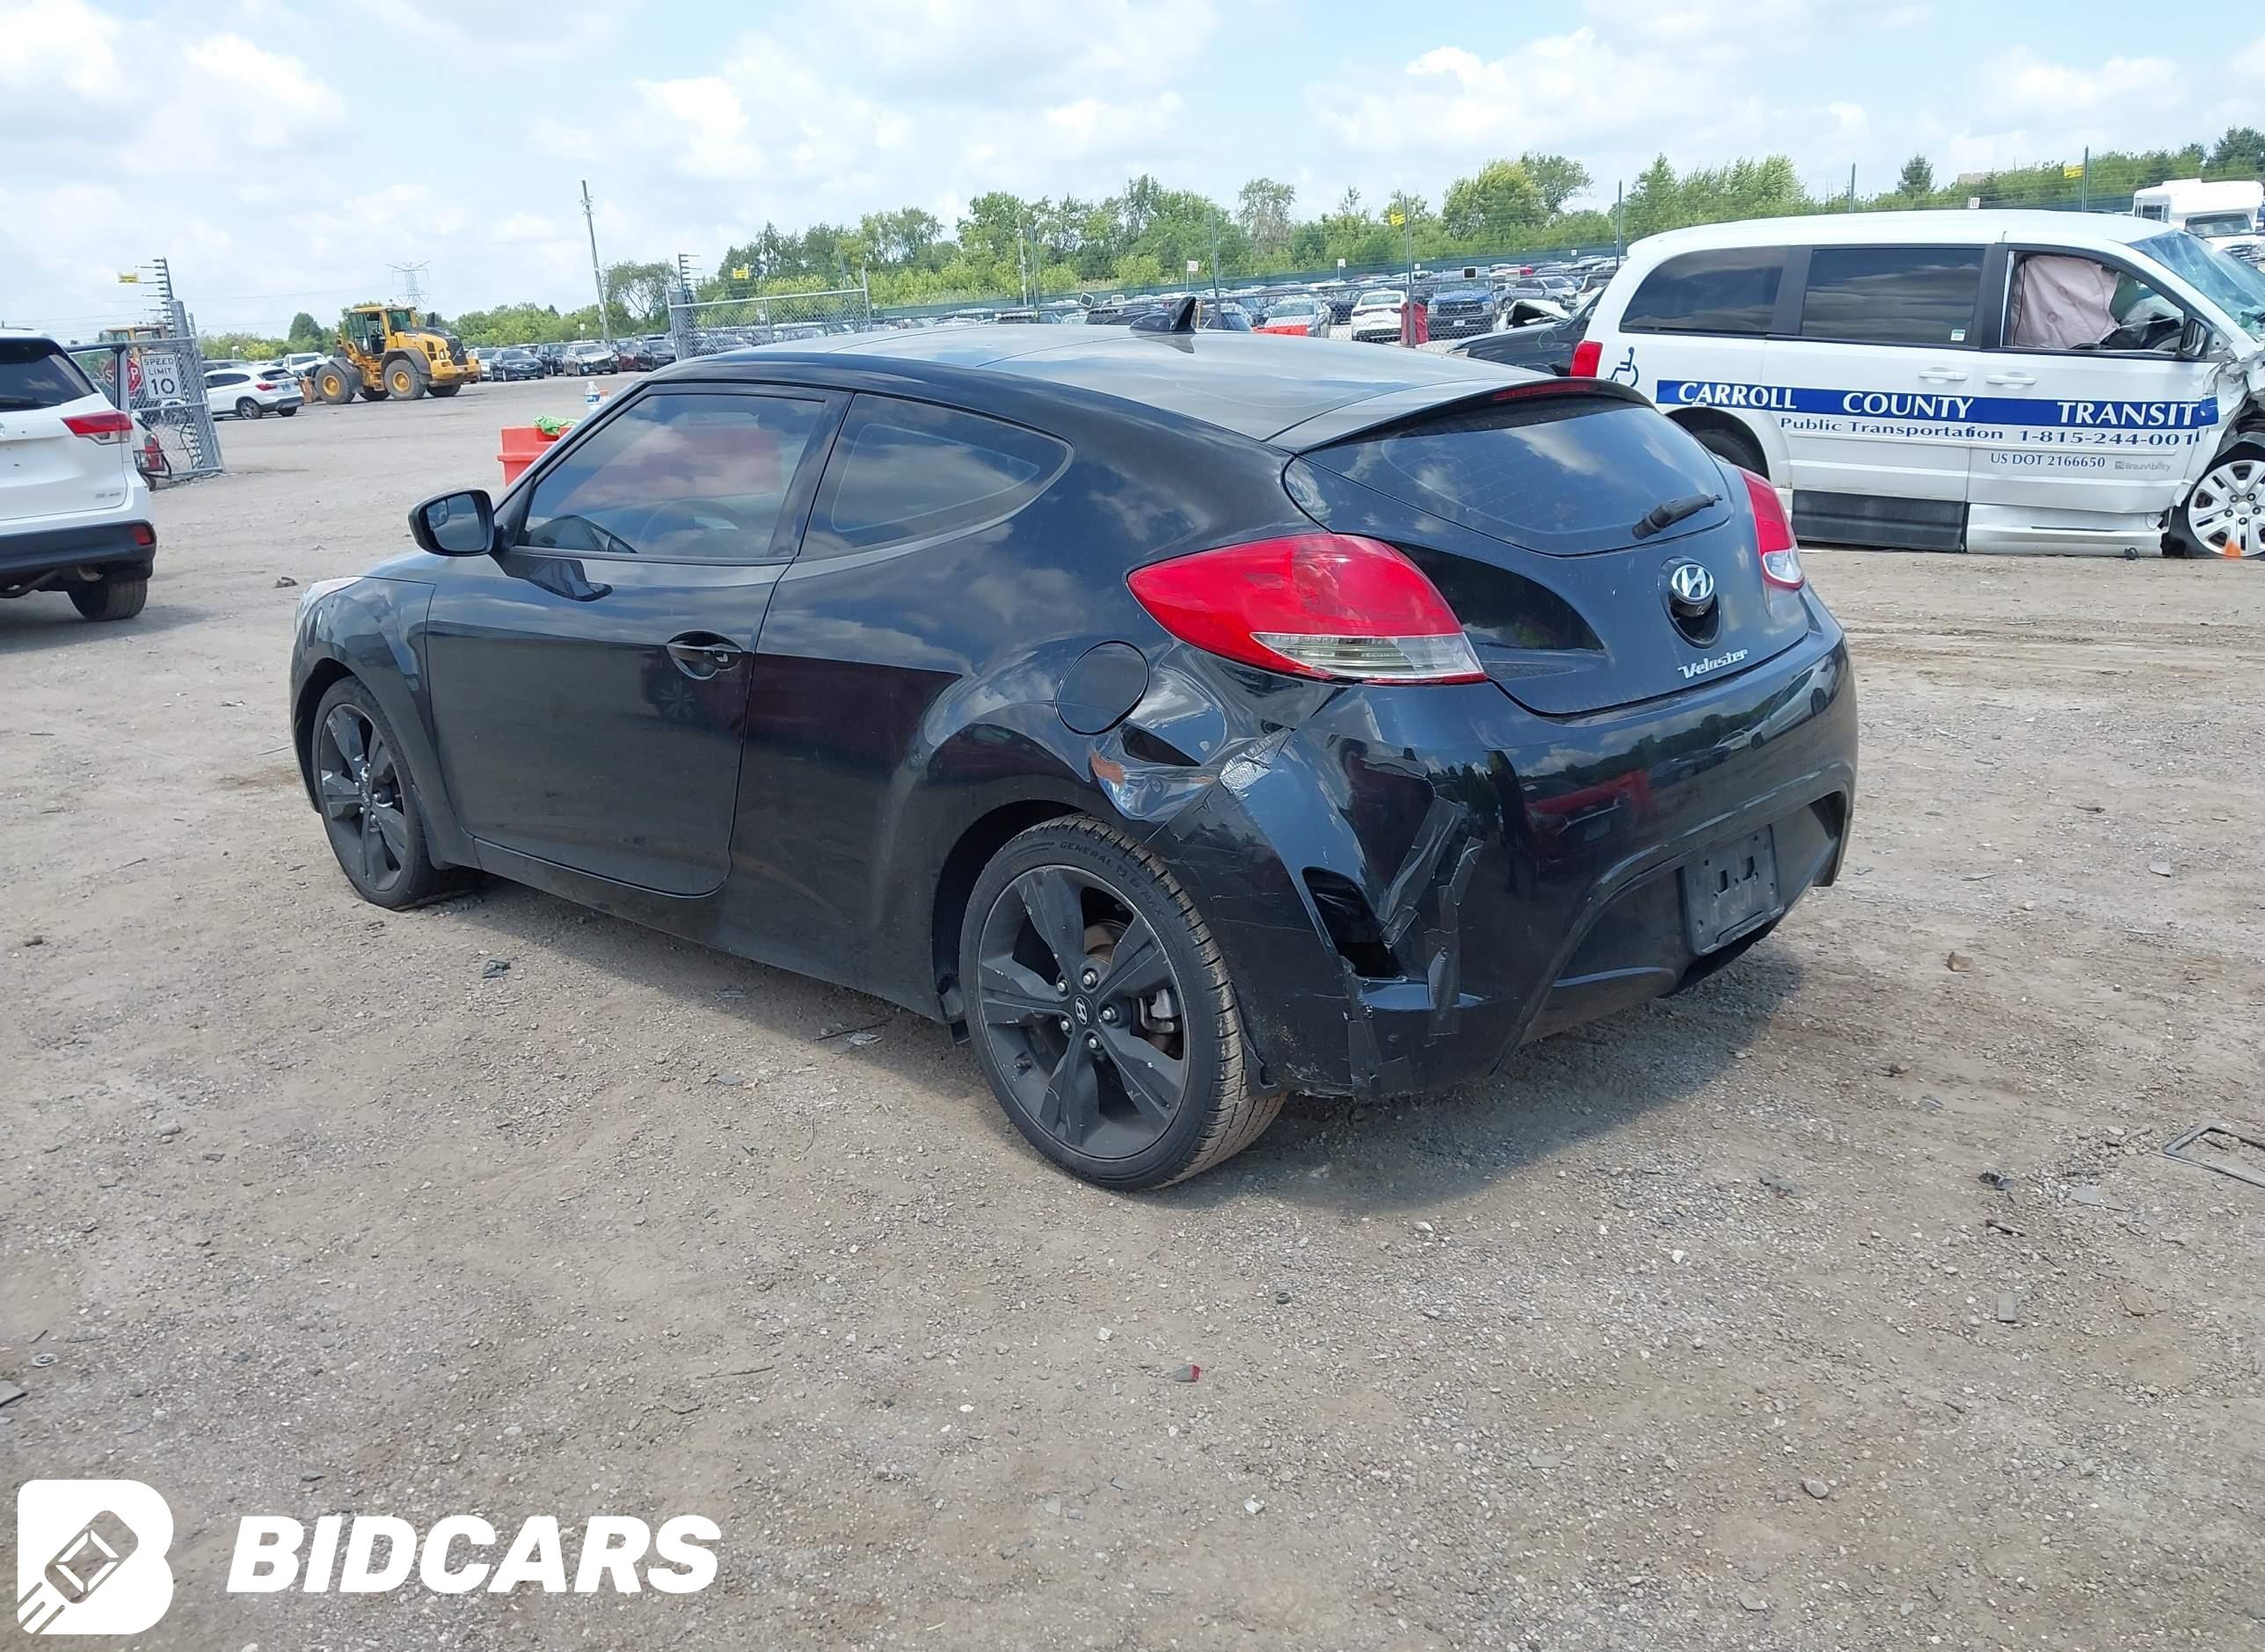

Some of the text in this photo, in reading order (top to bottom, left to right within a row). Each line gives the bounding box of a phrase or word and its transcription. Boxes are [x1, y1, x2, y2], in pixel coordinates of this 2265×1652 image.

[143, 357, 174, 366] SPEED
[105, 368, 139, 383] SP
[148, 368, 172, 376] LIMIT
[150, 378, 176, 395] 10
[1678, 382, 2200, 426] CARROLL COUNTY TRANSIT
[1780, 417, 1843, 432] Public
[1847, 421, 2004, 440] Transportation
[1990, 452, 2106, 468] US DOT 2166650
[1677, 647, 1749, 680] Veloster
[1060, 841, 1113, 869] GENERAL
